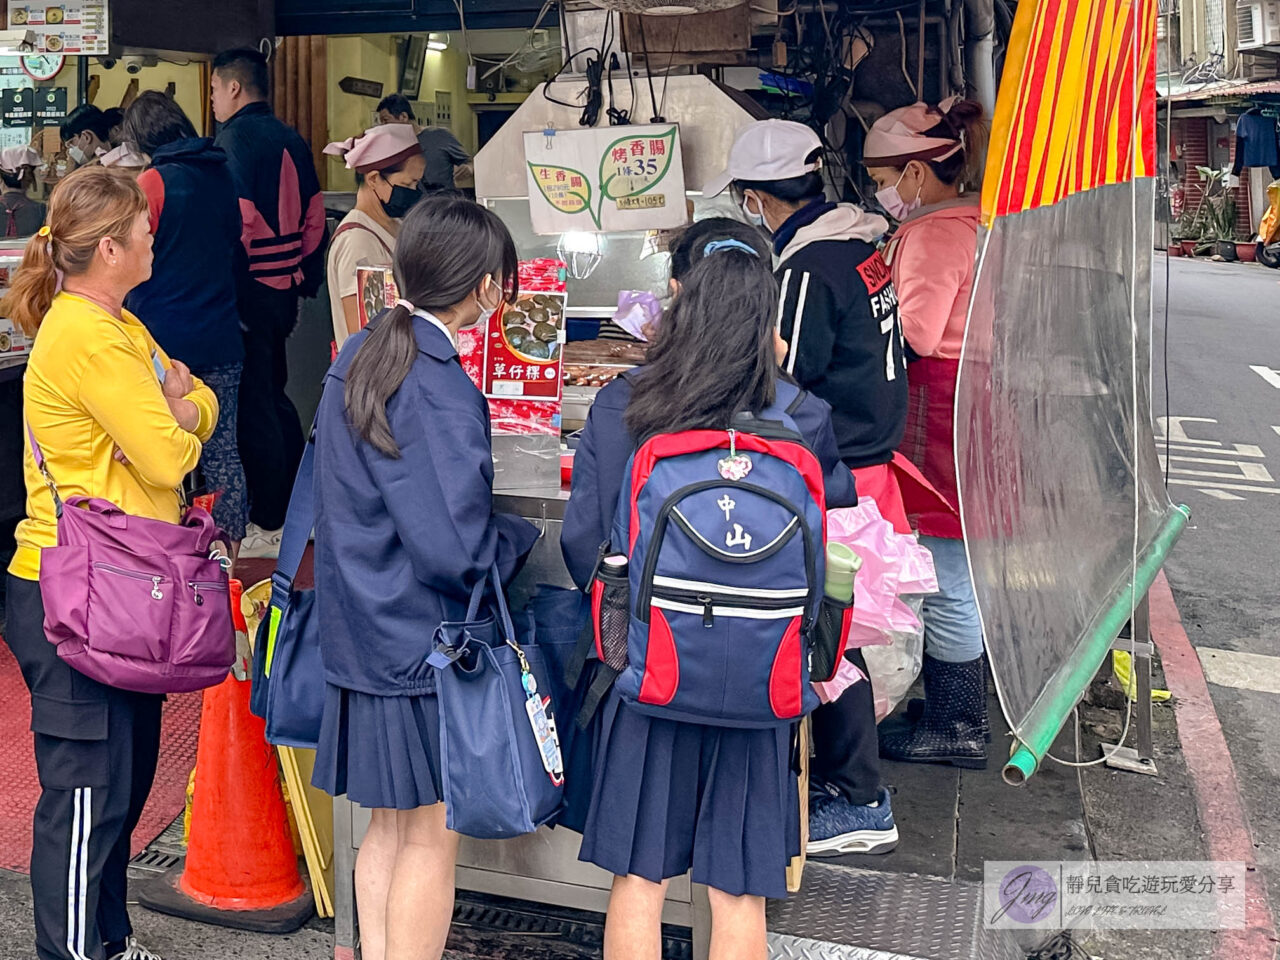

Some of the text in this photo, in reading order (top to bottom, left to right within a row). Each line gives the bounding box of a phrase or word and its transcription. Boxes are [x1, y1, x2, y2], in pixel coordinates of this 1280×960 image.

[612, 139, 665, 164] 烤香腸
[540, 168, 582, 188] 生香腸
[493, 363, 540, 380] 草仔粿
[717, 494, 752, 550] 中山
